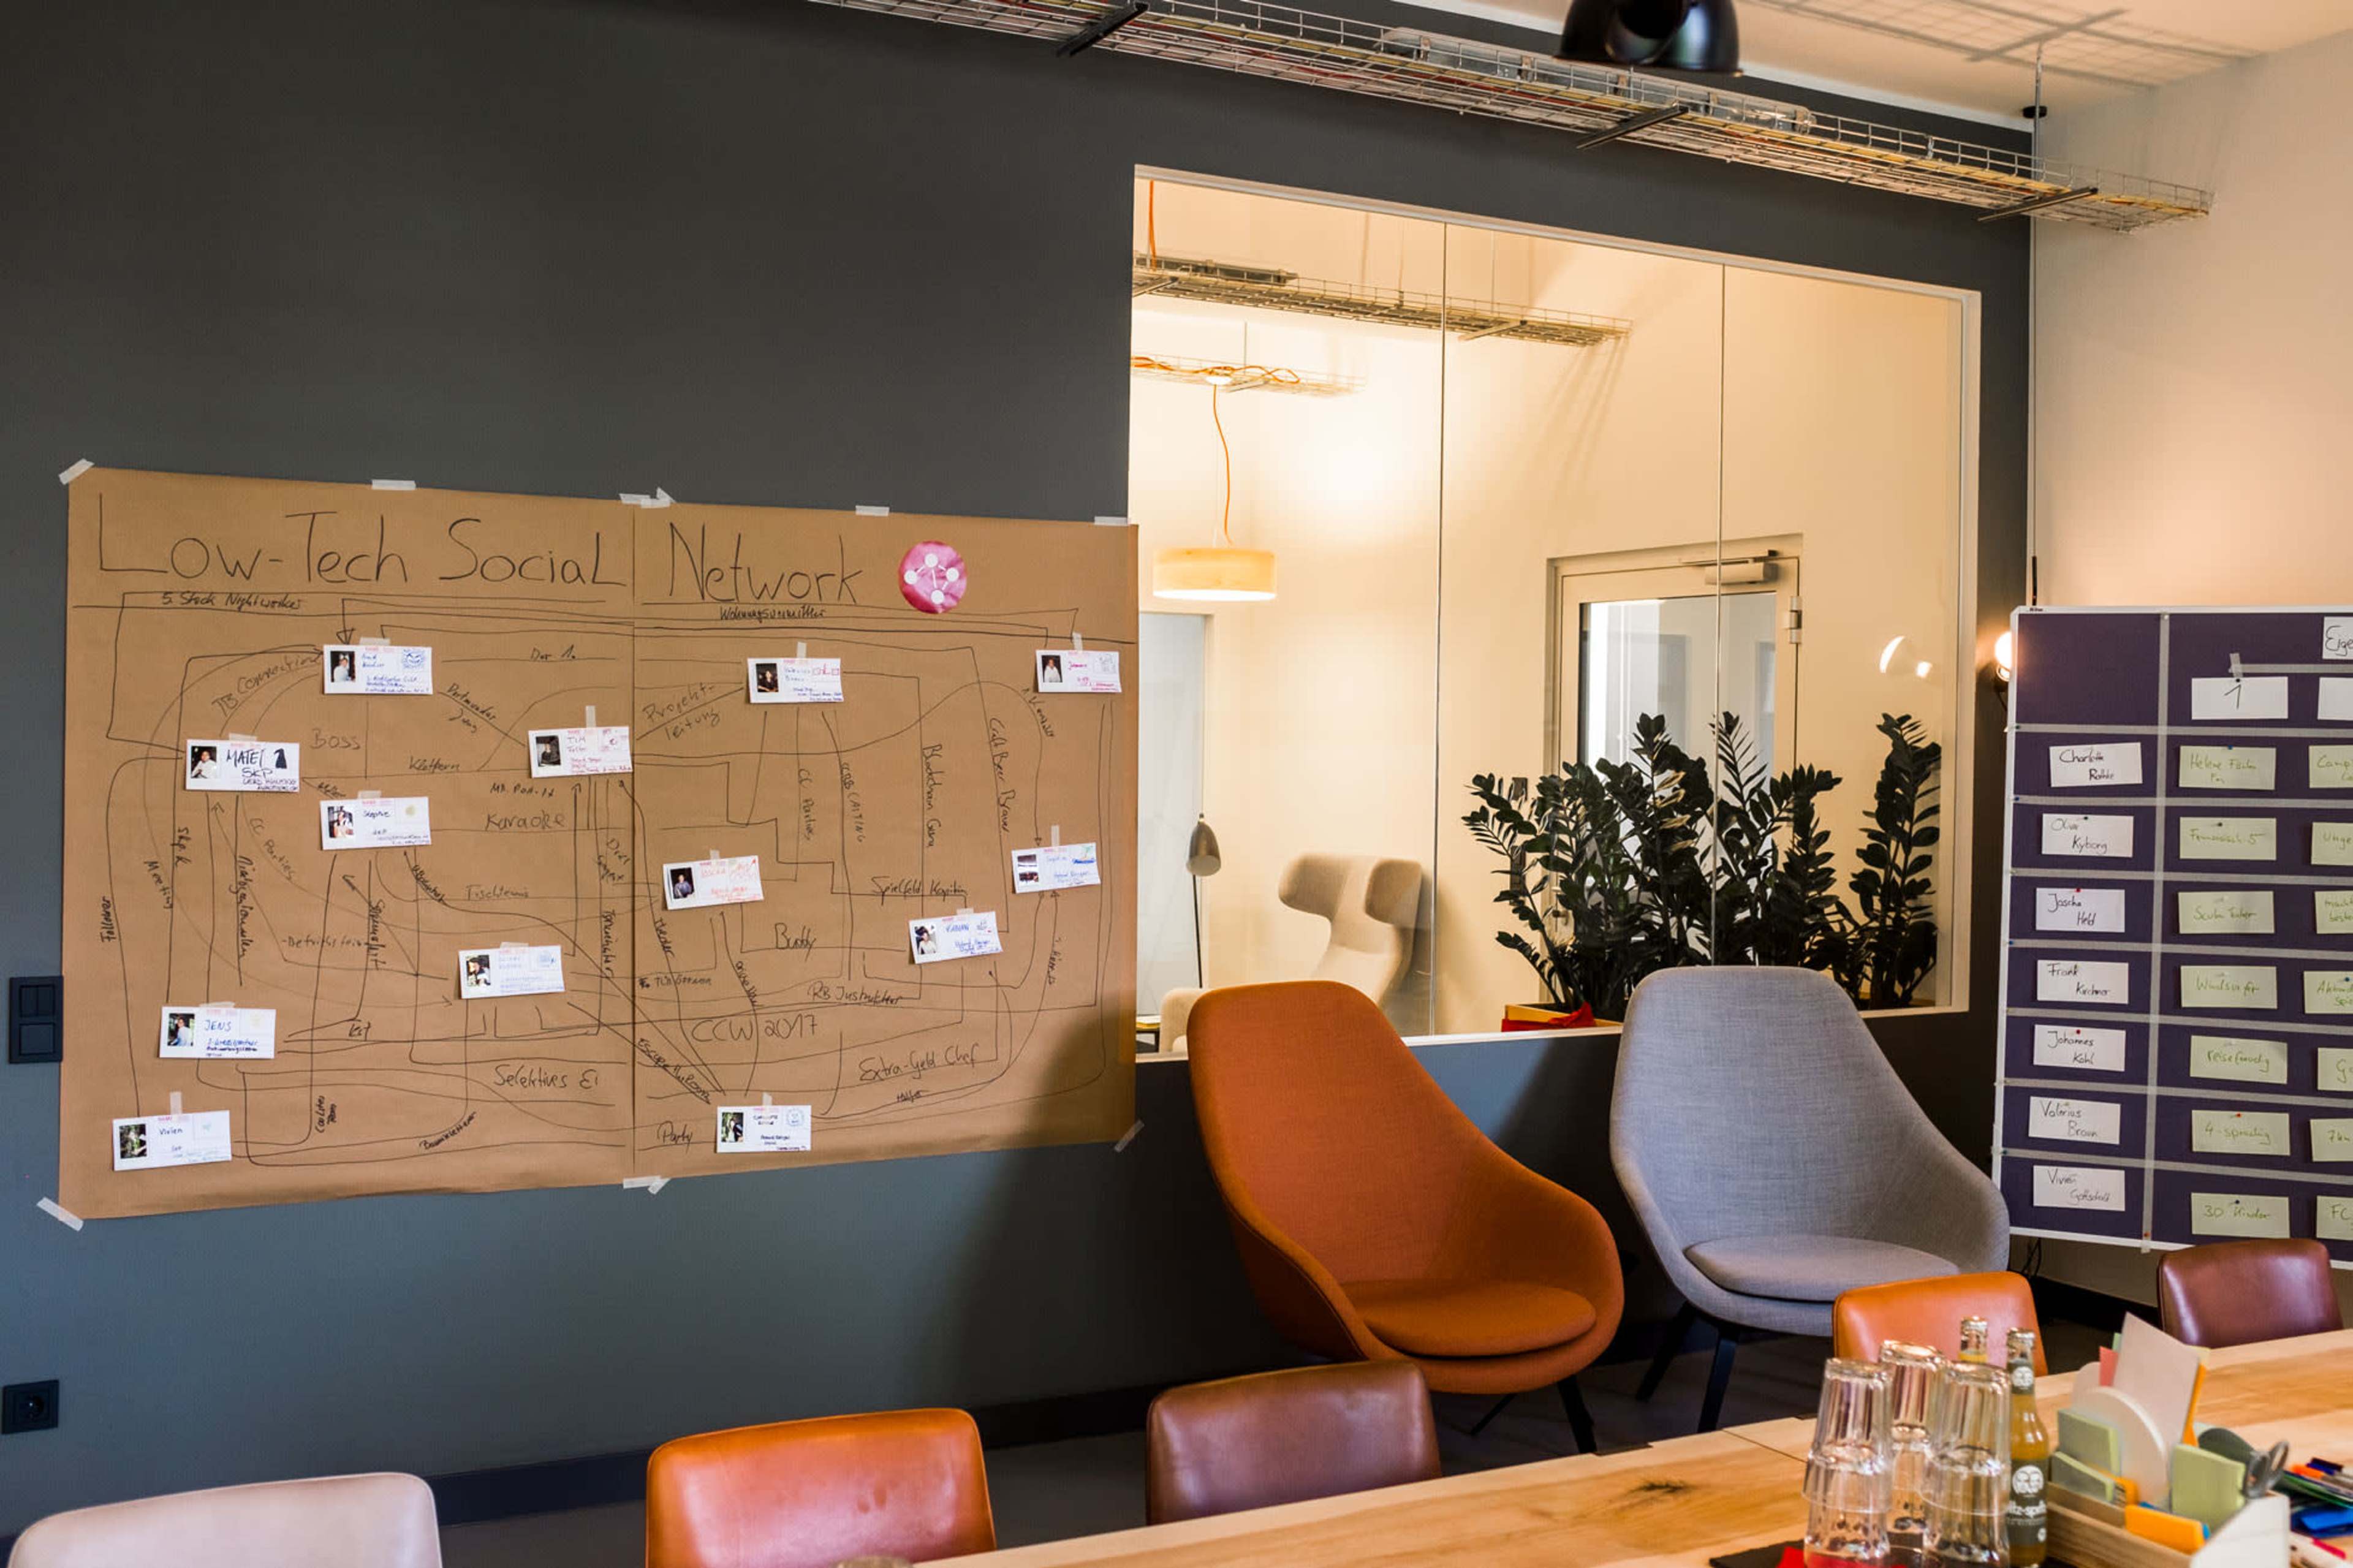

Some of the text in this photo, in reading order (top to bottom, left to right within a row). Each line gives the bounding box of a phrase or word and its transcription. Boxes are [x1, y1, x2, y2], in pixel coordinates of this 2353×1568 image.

[669, 522, 863, 604] Network
[2224, 684, 2241, 709] 1
[691, 1013, 819, 1042] CCW 2017
[657, 1121, 693, 1154] Party
